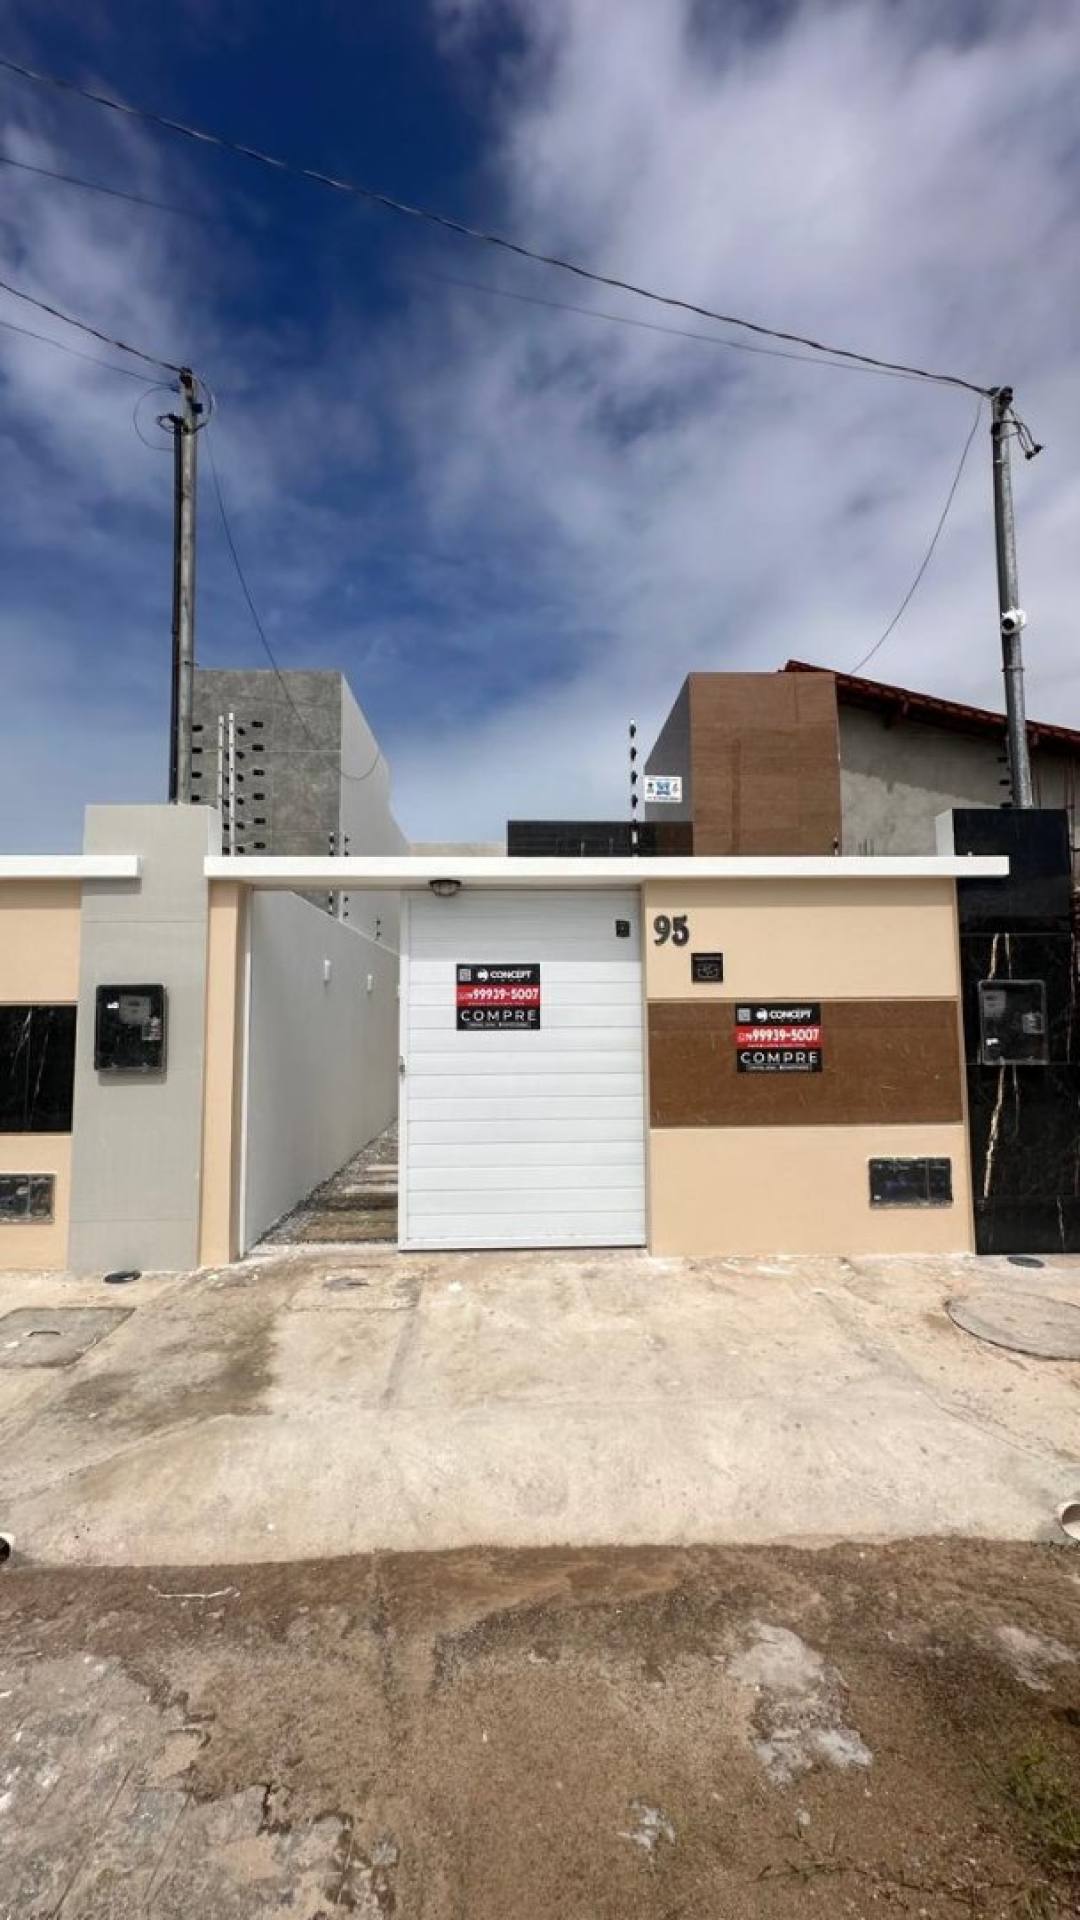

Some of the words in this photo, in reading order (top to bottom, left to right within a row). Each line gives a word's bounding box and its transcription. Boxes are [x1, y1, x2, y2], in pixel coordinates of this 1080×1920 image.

[653, 914, 690, 946] 95
[489, 970, 532, 979] CONCEPT
[473, 988, 539, 1000] 99939-5007
[460, 1010, 537, 1021] COMPRE
[769, 1009, 812, 1019] CONCEPT
[752, 1028, 819, 1041] 99939-5007
[740, 1051, 817, 1064] COMPRE
